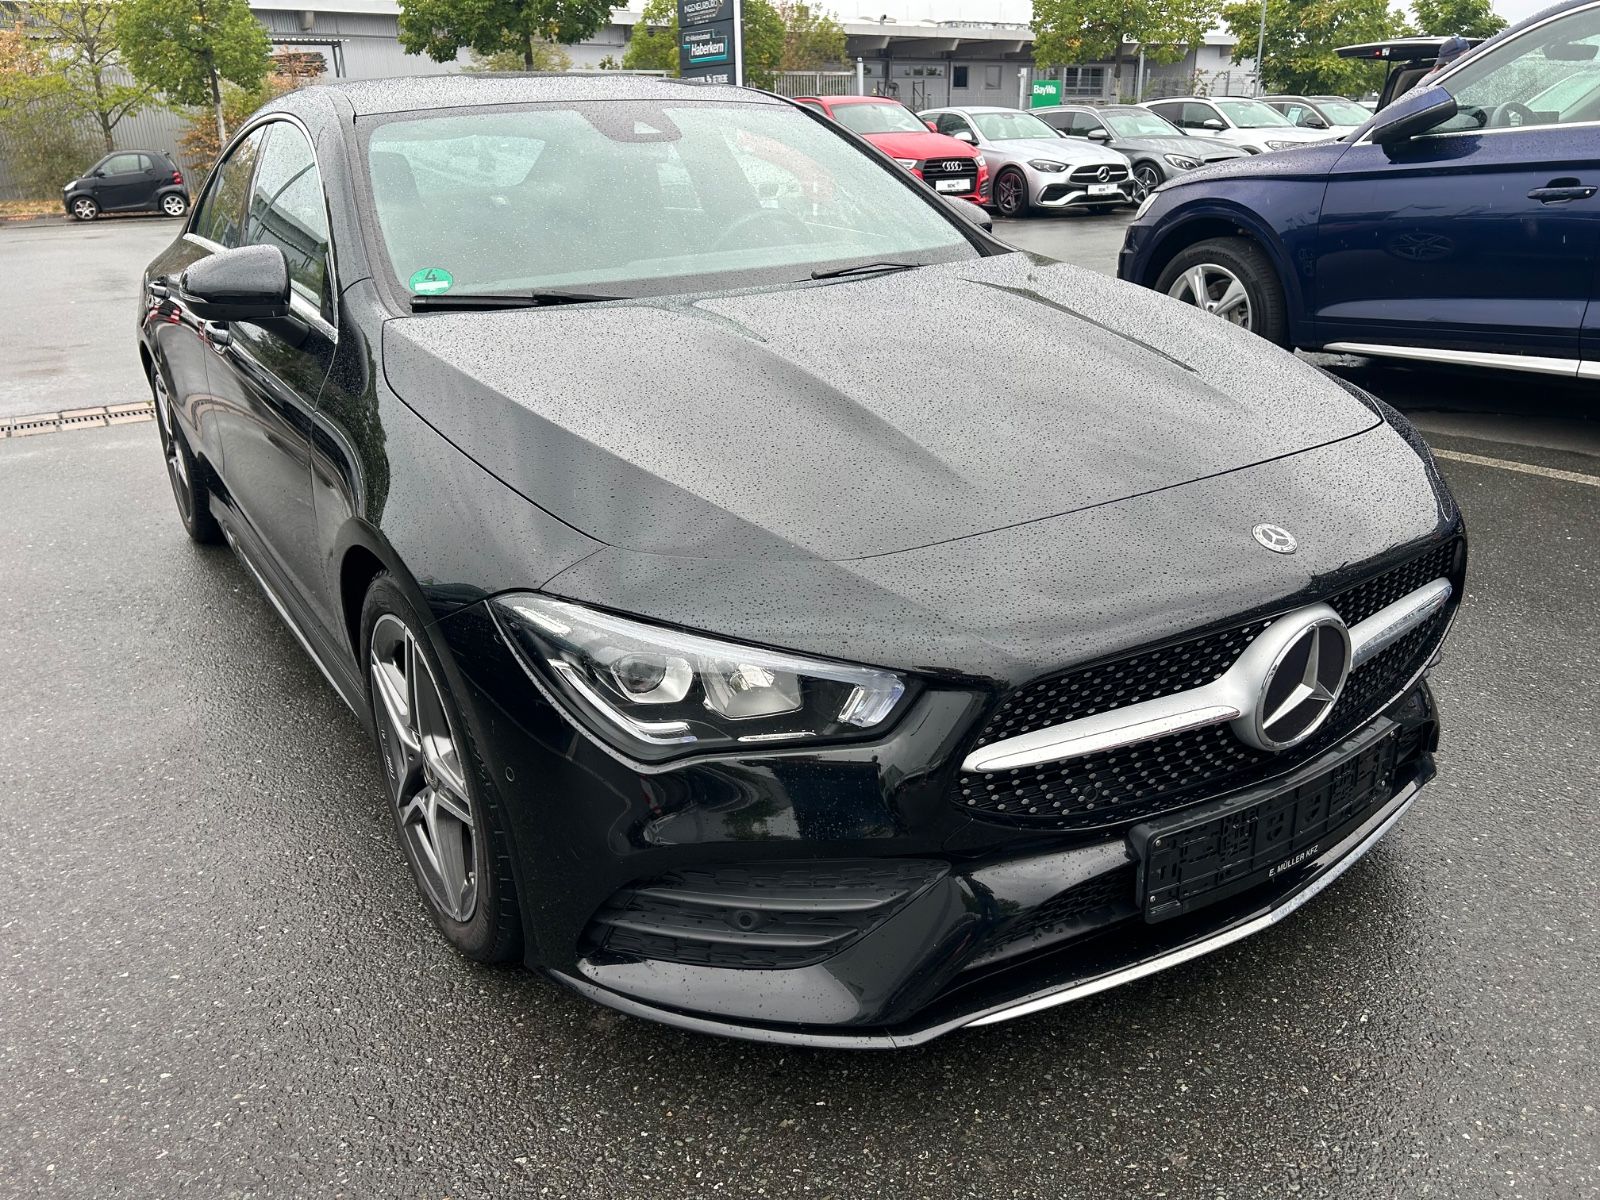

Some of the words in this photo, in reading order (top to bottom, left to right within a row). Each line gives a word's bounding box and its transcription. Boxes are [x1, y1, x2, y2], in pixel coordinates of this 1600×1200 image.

[691, 41, 724, 56] Haberkern
[1033, 84, 1057, 95] BayWa
[424, 269, 437, 281] 4
[1268, 868, 1276, 877] E.
[1276, 852, 1305, 873] MÜLLER
[1305, 844, 1319, 858] KFZ
